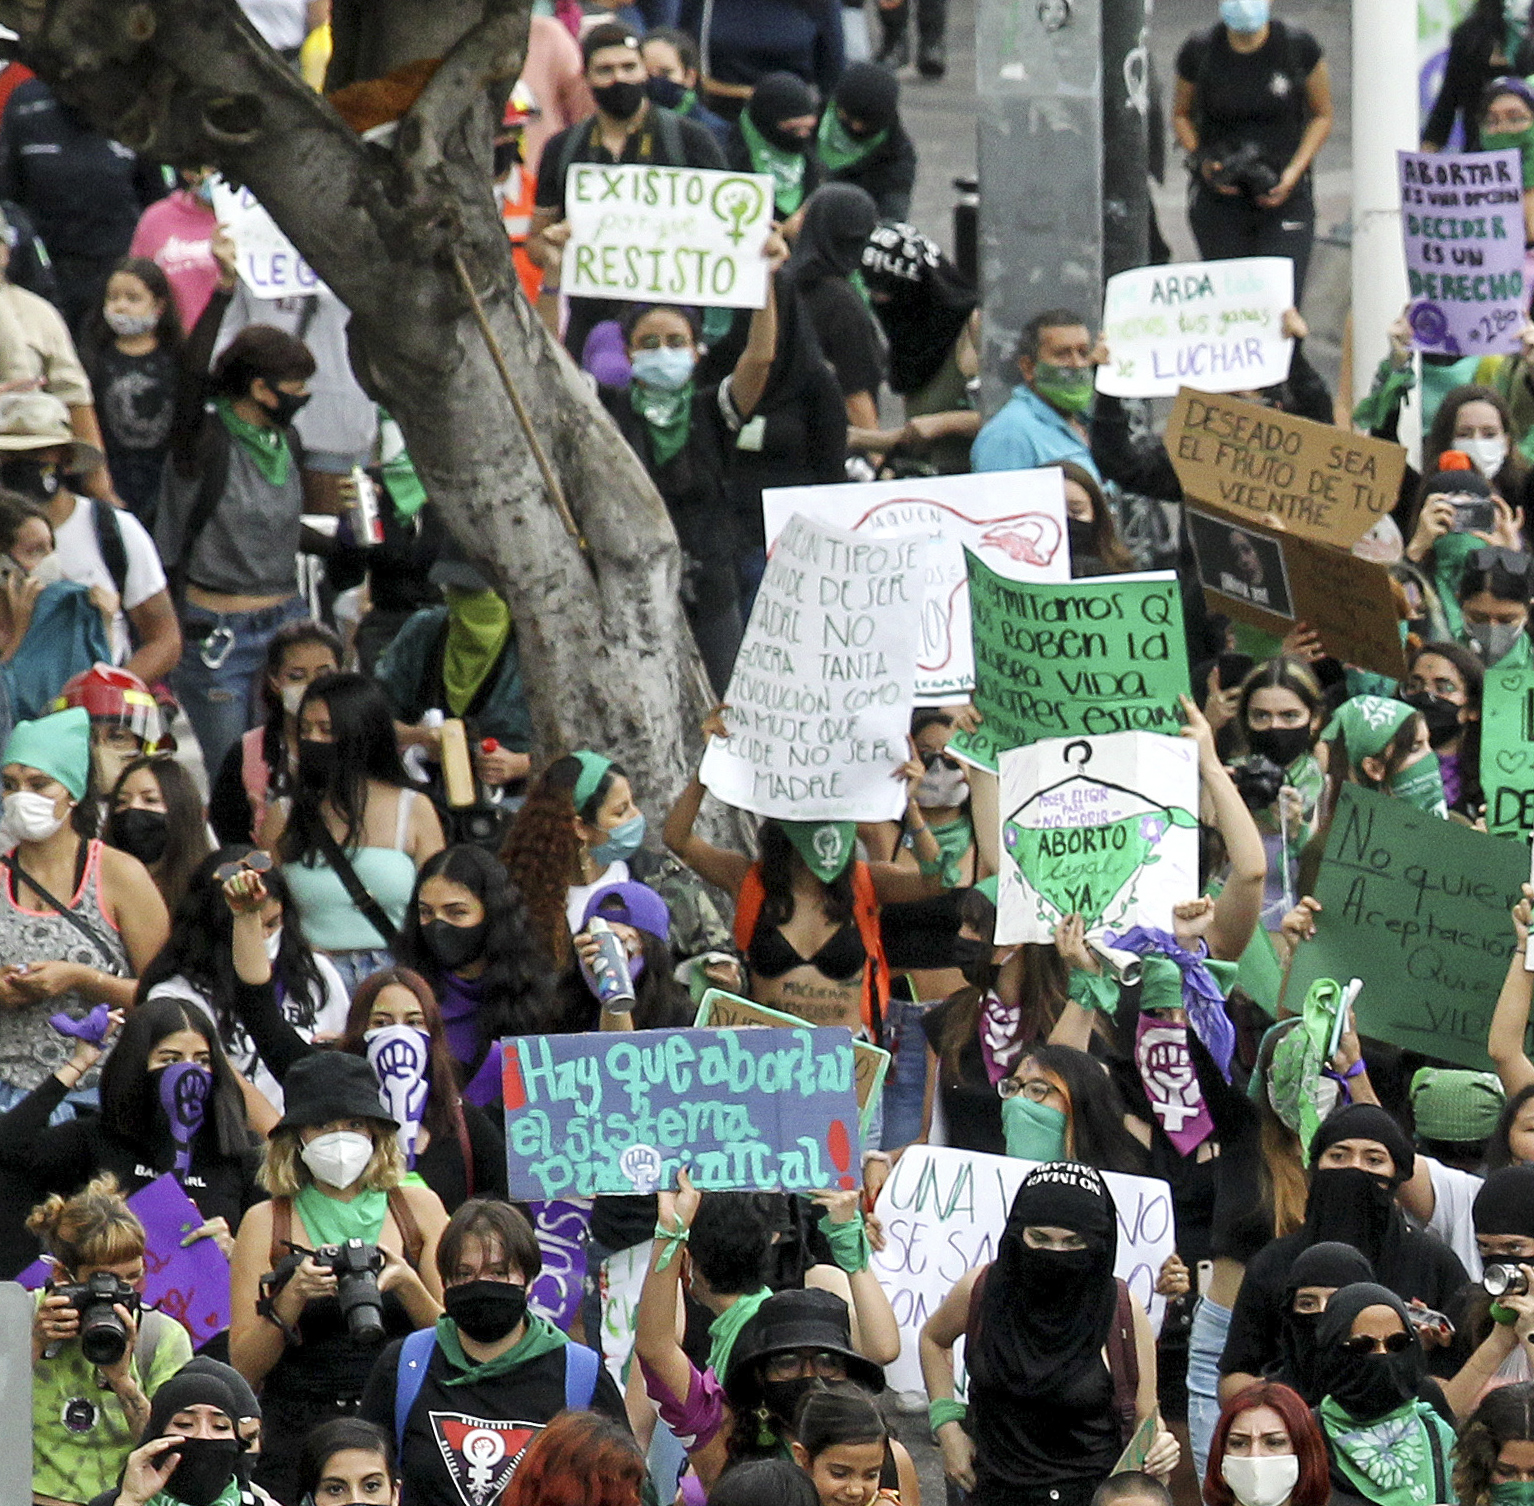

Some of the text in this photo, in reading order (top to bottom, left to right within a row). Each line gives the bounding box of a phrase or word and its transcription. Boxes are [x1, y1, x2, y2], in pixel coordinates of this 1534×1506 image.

[1404, 160, 1511, 186] ABORTAR
[1408, 215, 1507, 239] DECIDIR
[574, 243, 736, 295] RESISTO
[1151, 273, 1214, 303] ARDA
[1409, 270, 1523, 300] DERECHO
[1153, 338, 1264, 378] LUCHAR
[1184, 398, 1378, 479] DESEADO SEA
[1219, 481, 1332, 528] VIENTRE
[789, 744, 827, 766] NO
[753, 770, 842, 800] MADRE
[1038, 825, 1127, 856] ABORTO
[510, 1099, 761, 1163] el sistema
[892, 1162, 979, 1223] UNA
